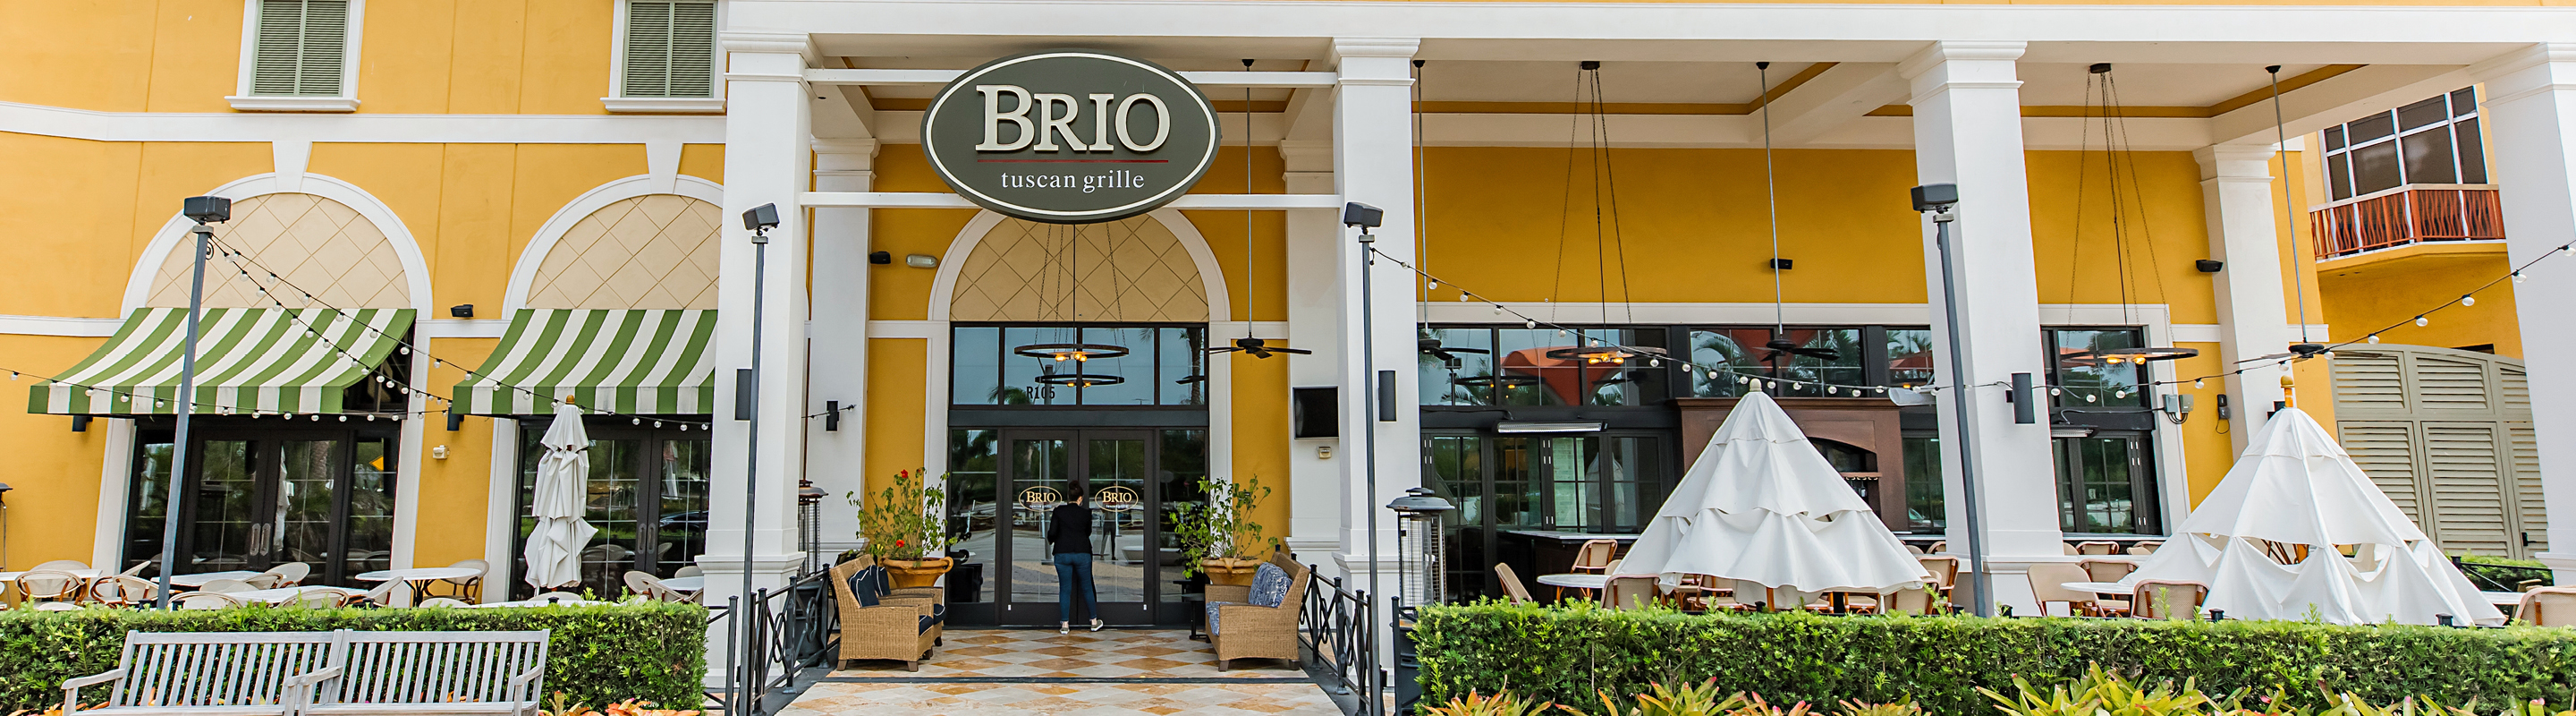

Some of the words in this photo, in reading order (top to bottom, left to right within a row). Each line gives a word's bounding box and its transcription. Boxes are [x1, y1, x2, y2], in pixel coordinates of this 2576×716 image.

[975, 84, 1171, 152] BRIO
[1001, 171, 1076, 189] tuscan
[1082, 169, 1145, 193] grille
[1026, 490, 1056, 503] BRIO
[1102, 490, 1132, 503] BRIO
